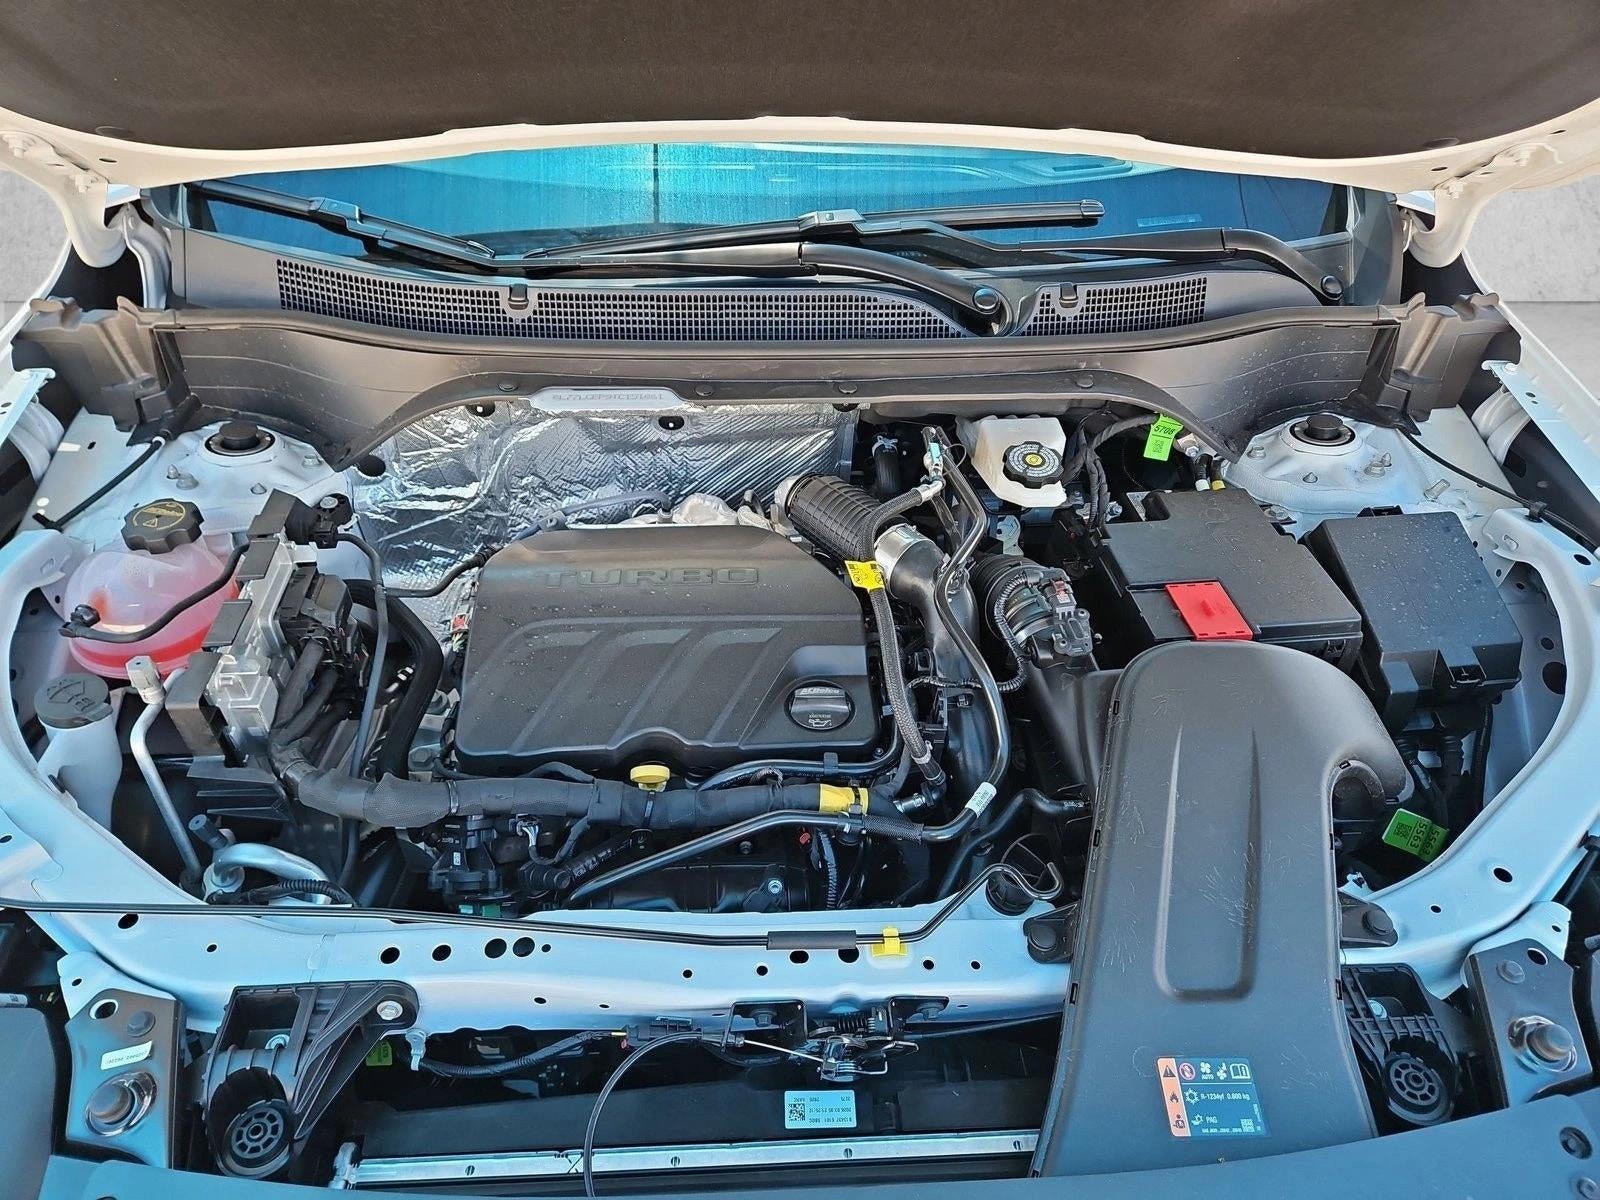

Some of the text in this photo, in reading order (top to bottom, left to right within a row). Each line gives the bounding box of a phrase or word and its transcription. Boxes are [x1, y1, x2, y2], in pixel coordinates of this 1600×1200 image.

[1154, 424, 1176, 435] 5708
[534, 567, 759, 589] TURBO
[1410, 820, 1428, 849] 5563
[1201, 1073, 1215, 1081] AUTO
[1205, 1115, 1218, 1124] PAG
